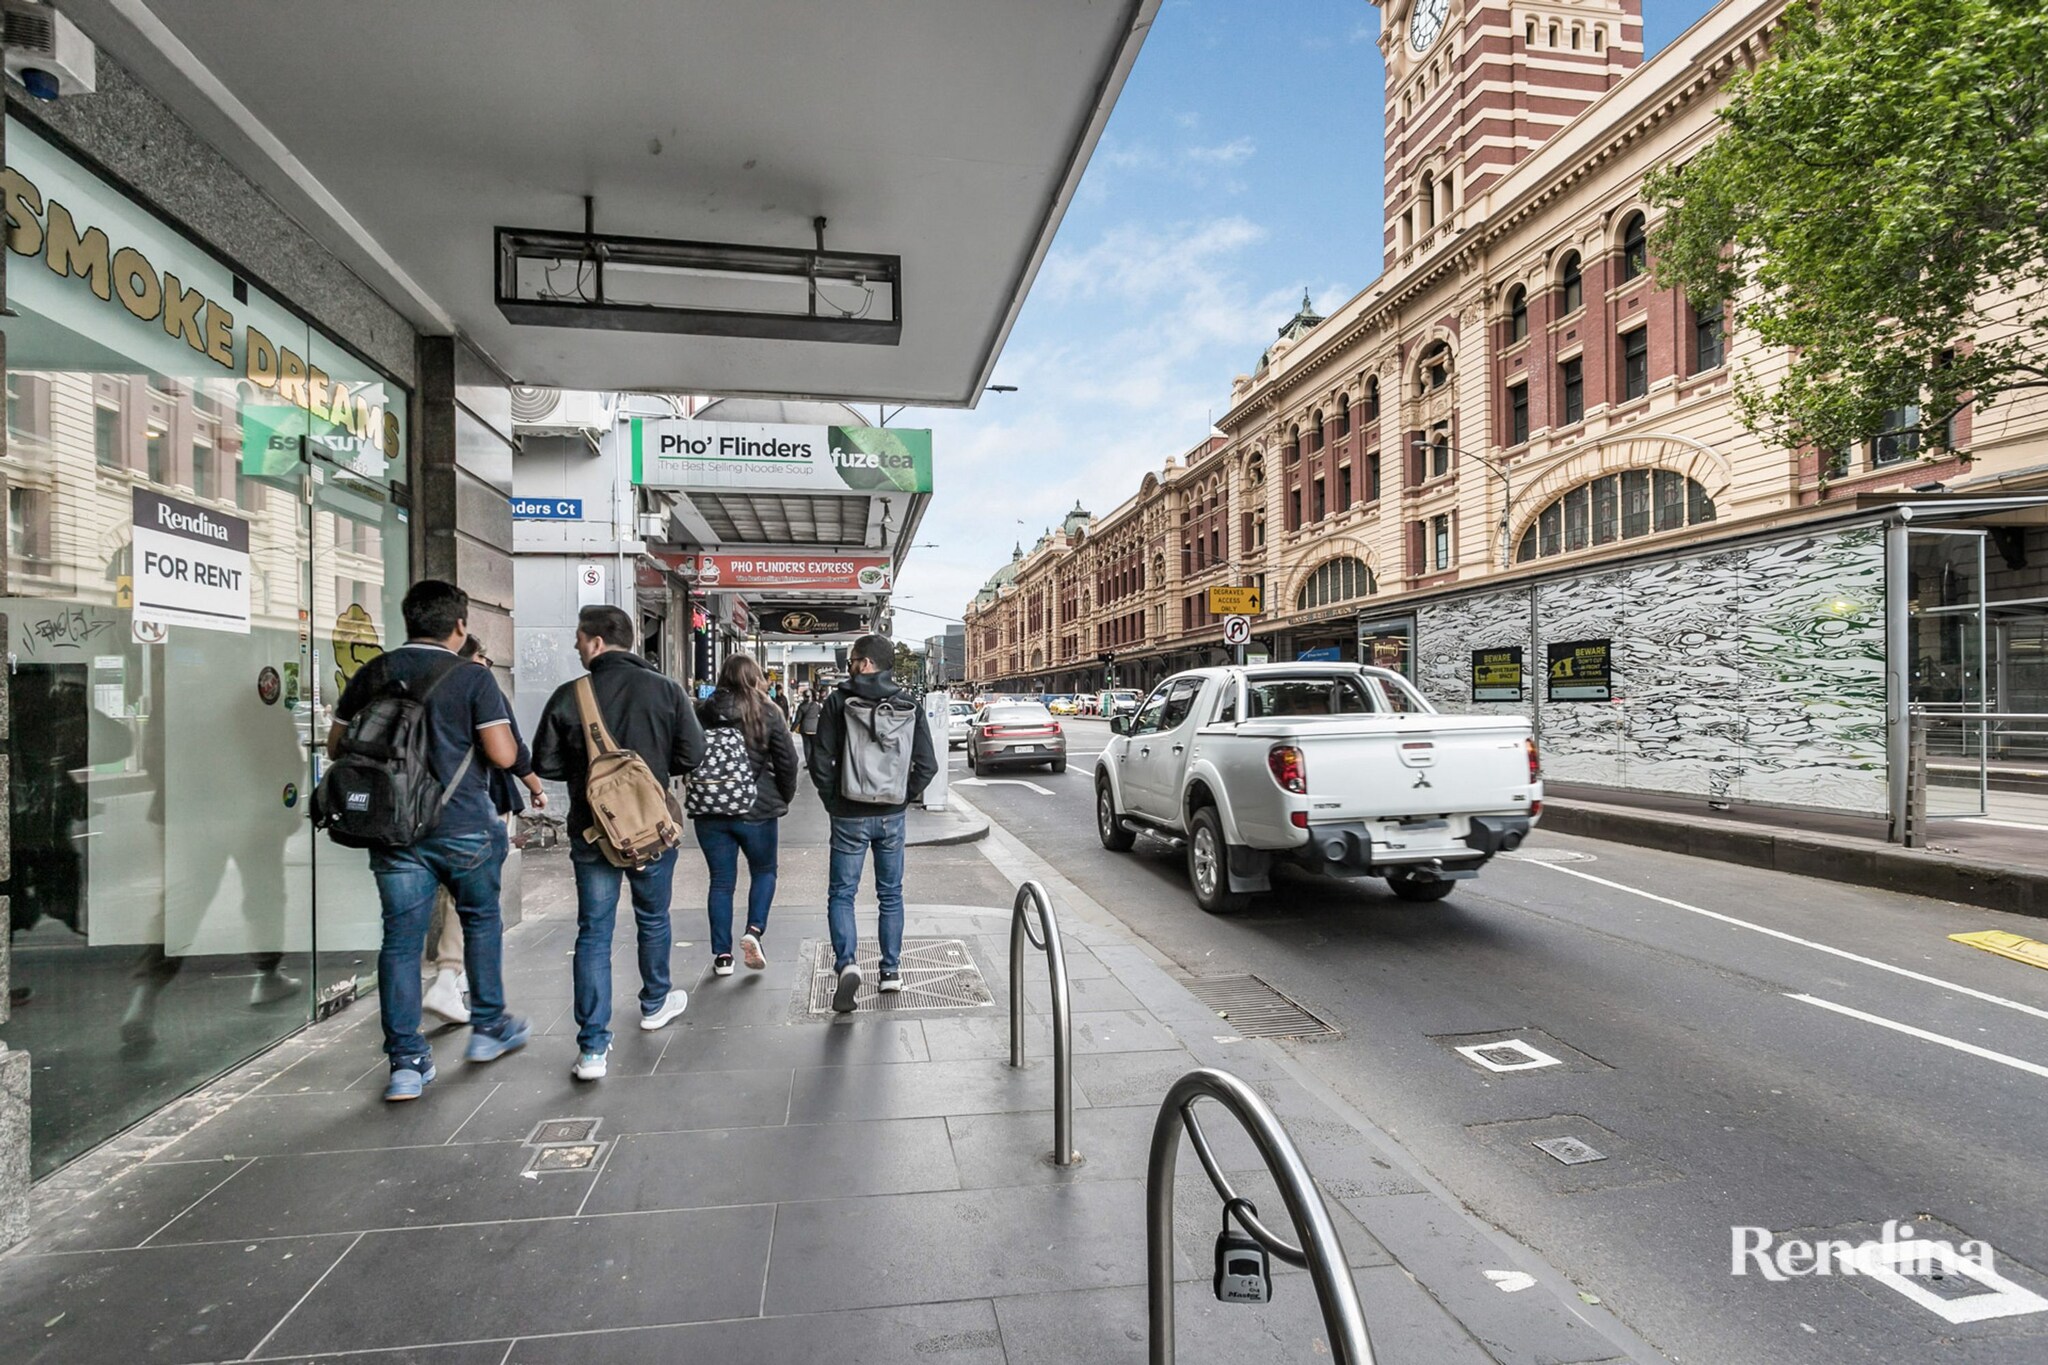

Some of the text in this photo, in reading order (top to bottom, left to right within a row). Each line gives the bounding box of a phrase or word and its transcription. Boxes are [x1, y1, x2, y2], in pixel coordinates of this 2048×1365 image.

[0, 166, 400, 459] SMOKE DREAMS
[720, 437, 812, 458] Flinders
[659, 460, 813, 475] The Best Selling Noodle Soup
[557, 502, 576, 515] Ct
[158, 502, 229, 542] Rendina
[144, 550, 242, 591] FOR RENT
[731, 561, 854, 574] PHO FLINDERS EXPRESS
[1213, 588, 1245, 596] DEGRAVES
[1484, 653, 1511, 663] BEWARE
[1575, 647, 1606, 657] BEWARE
